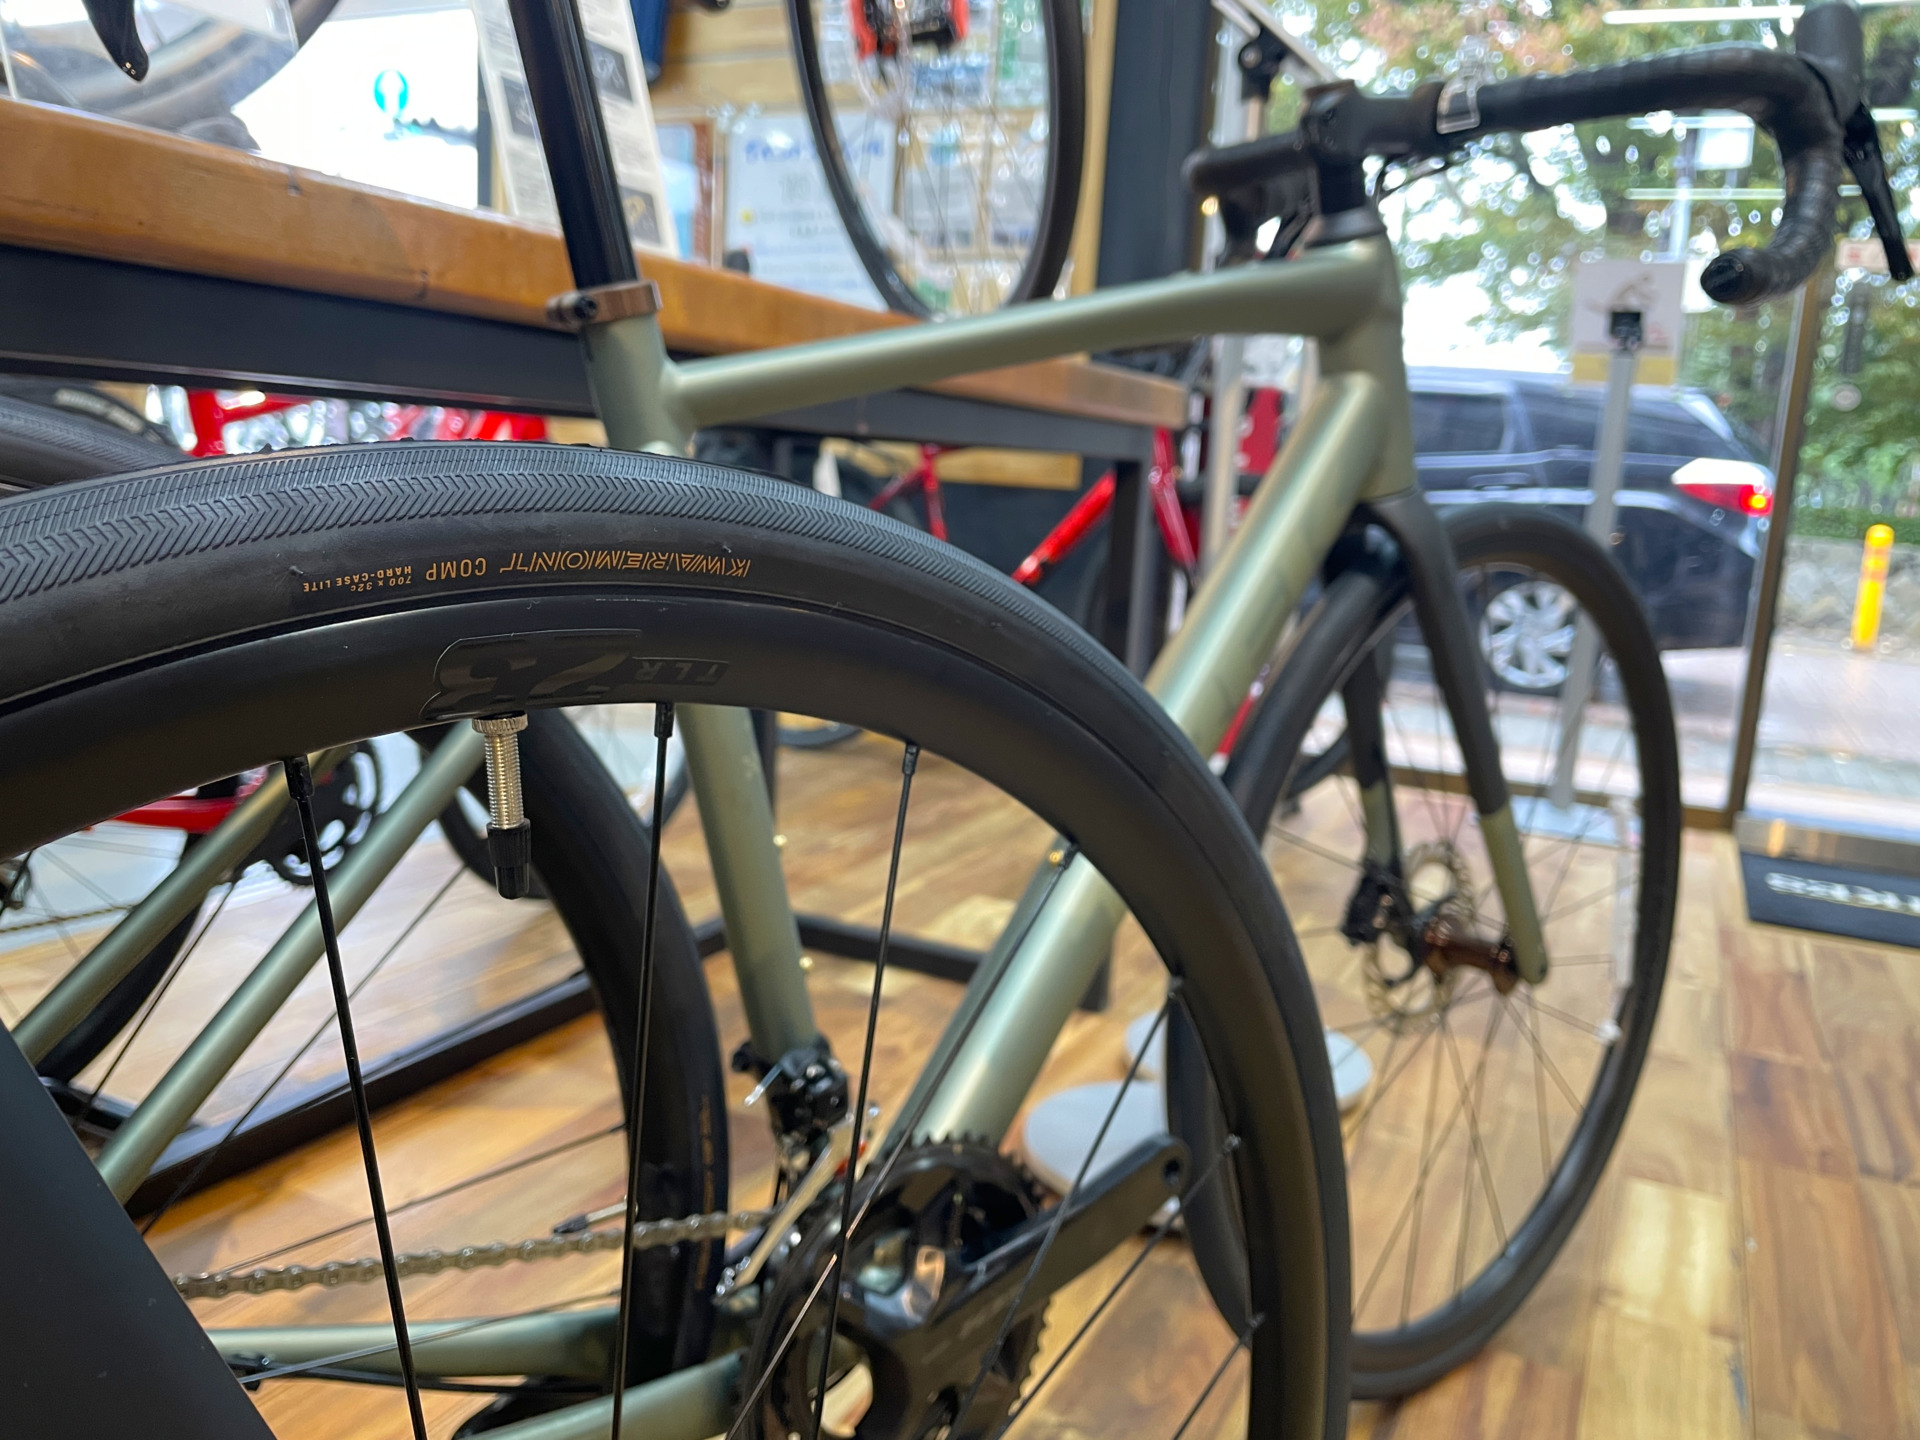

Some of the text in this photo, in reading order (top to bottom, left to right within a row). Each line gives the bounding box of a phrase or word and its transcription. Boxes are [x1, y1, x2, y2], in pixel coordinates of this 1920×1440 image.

[425, 550, 751, 581] KWAREMONT COMP
[303, 565, 412, 593] HARD-CASE LITE
[350, 581, 373, 592] 32c
[389, 575, 412, 587] 700
[634, 660, 720, 683] TLR
